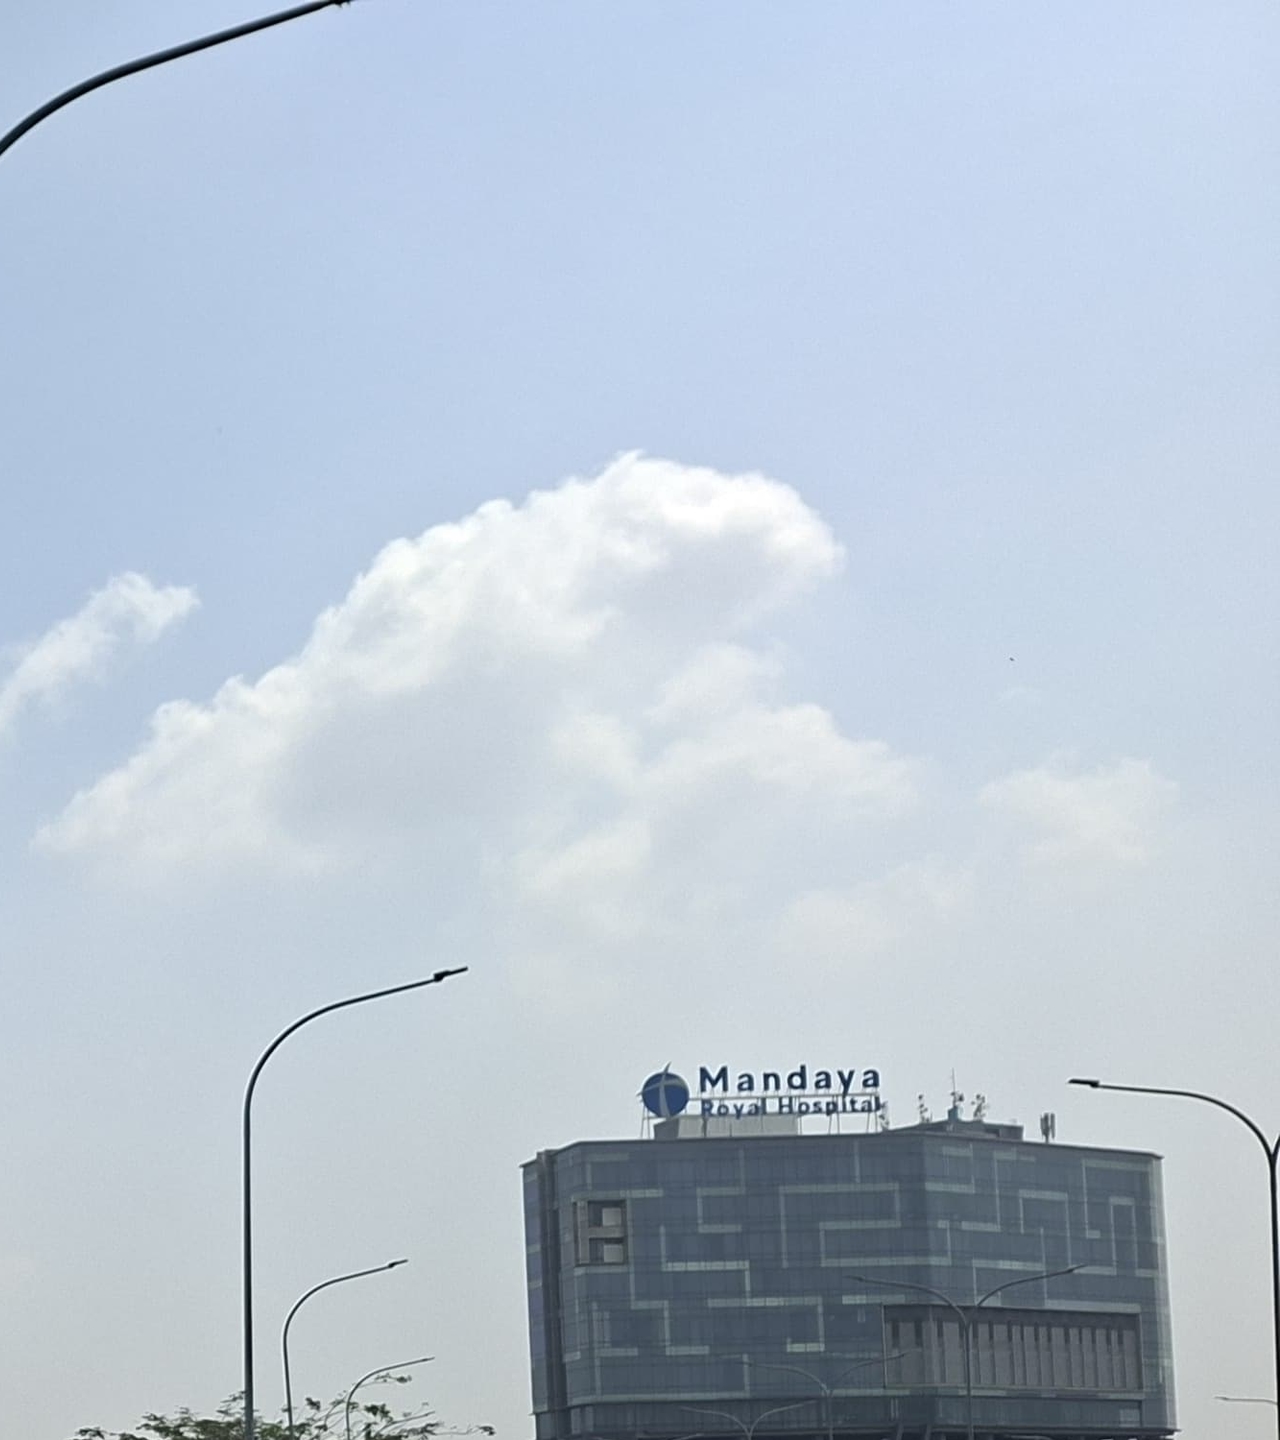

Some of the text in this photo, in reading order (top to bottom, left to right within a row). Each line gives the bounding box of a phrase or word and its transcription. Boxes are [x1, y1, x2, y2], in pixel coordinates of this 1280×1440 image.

[698, 1064, 881, 1099] Mandaya
[701, 1096, 882, 1119] Royal Hospital
